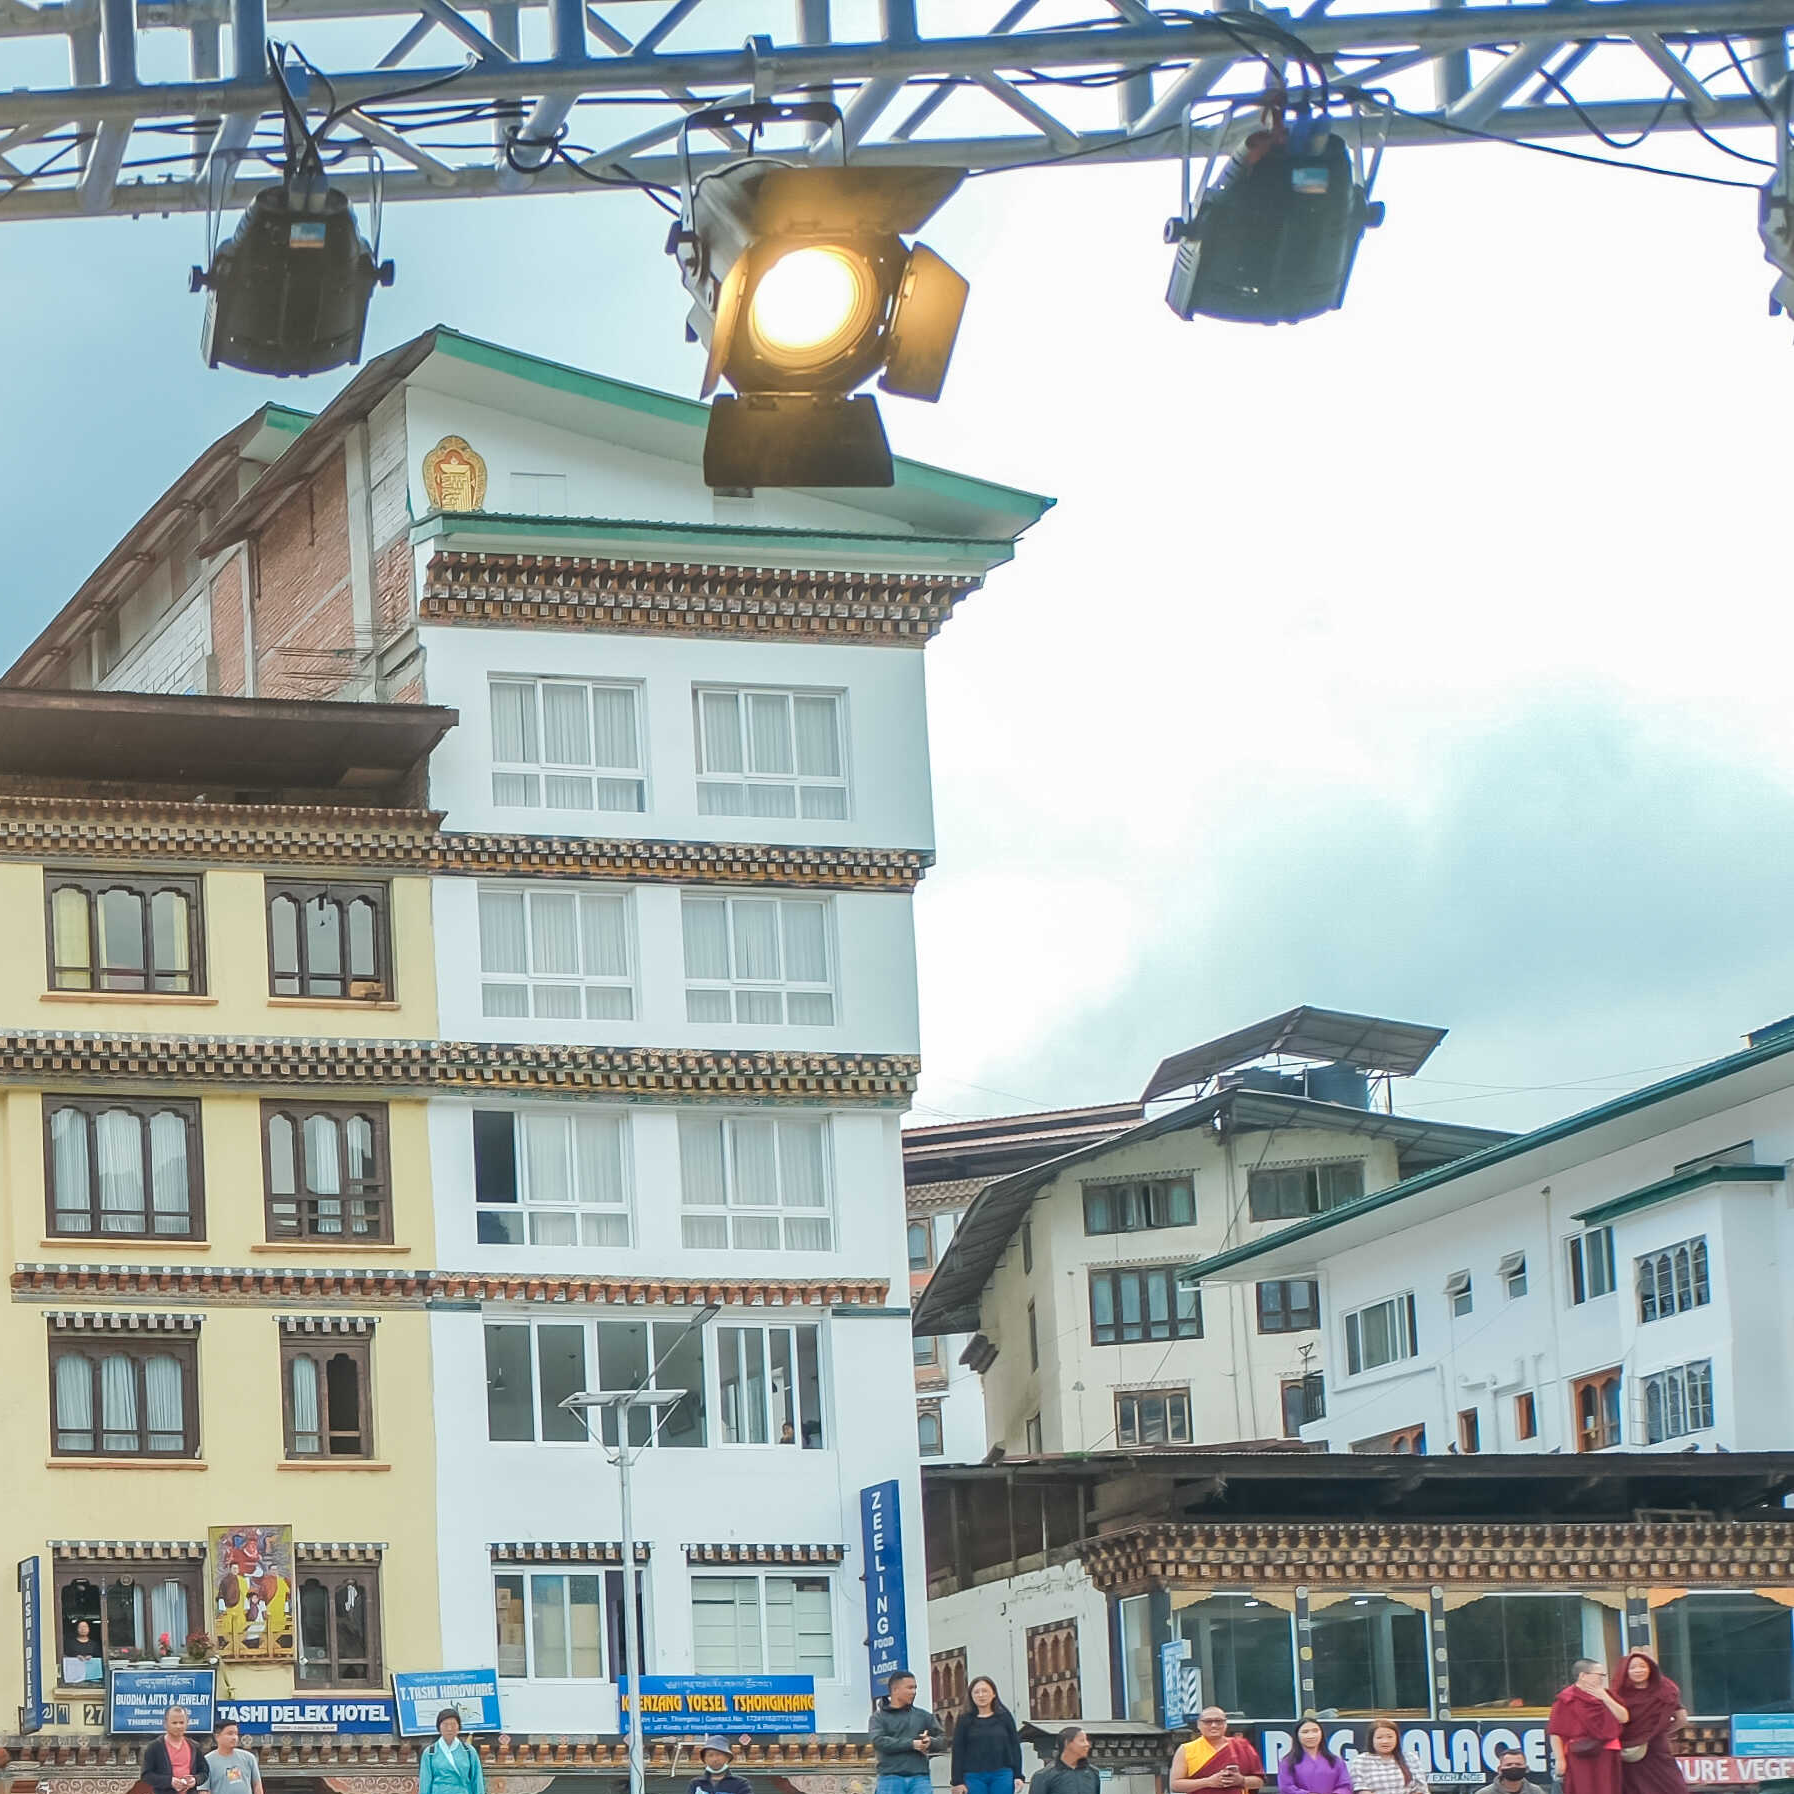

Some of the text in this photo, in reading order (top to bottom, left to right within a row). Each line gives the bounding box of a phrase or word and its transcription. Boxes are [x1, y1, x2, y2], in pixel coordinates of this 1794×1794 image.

[871, 1491, 889, 1635] ZEELING
[873, 1636, 894, 1649] FOOD
[872, 1660, 898, 1675] LODGE
[115, 1693, 147, 1706] BUDDHA
[621, 1694, 683, 1712] KENZANG
[686, 1694, 728, 1712] YOESEL
[217, 1705, 268, 1722] TASHI
[271, 1705, 331, 1722] DELEK
[332, 1705, 391, 1721] HOTEL
[1401, 1728, 1547, 1773] ALACE
[1677, 1759, 1730, 1781] URE
